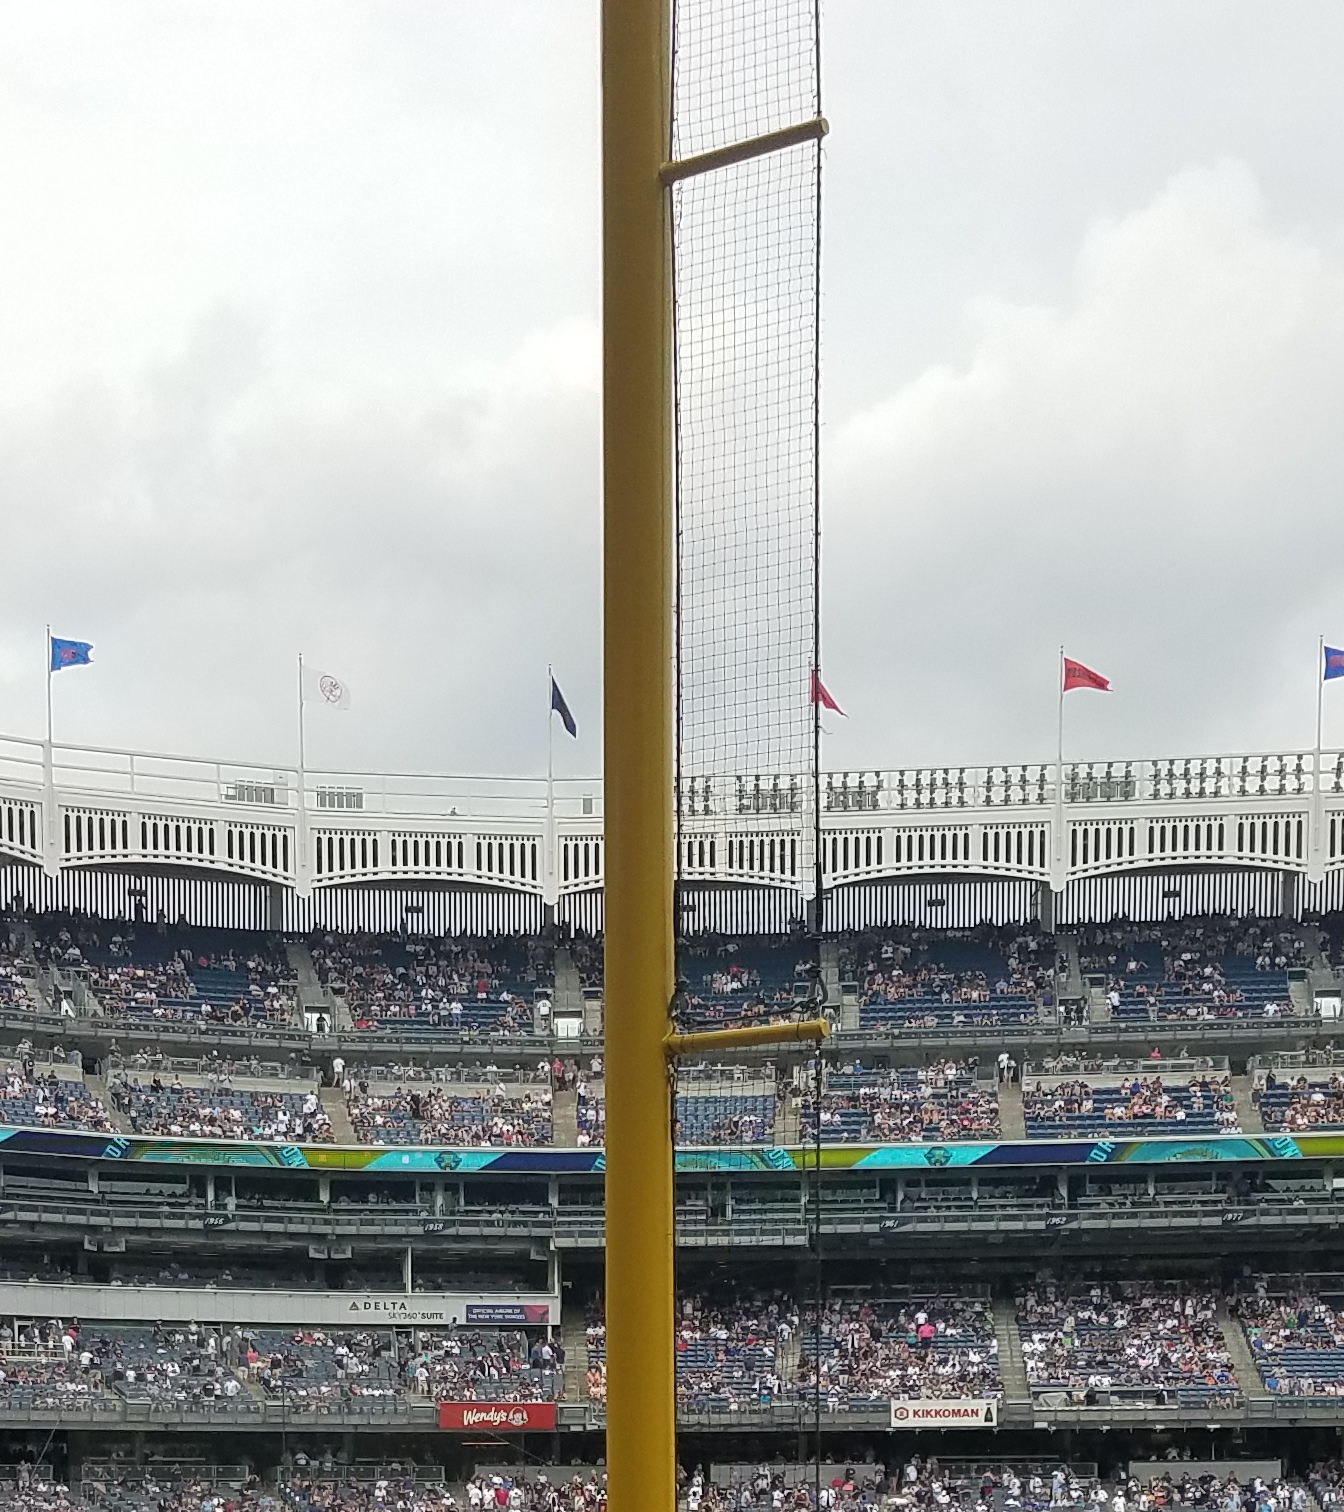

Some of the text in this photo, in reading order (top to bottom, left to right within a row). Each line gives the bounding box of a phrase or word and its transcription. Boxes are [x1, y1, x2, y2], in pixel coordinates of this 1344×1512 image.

[1222, 1212, 1244, 1222] 1977
[363, 1302, 408, 1311] DELTA
[463, 1409, 507, 1426] Wendy's
[912, 1408, 979, 1419] KIKKOMAN
